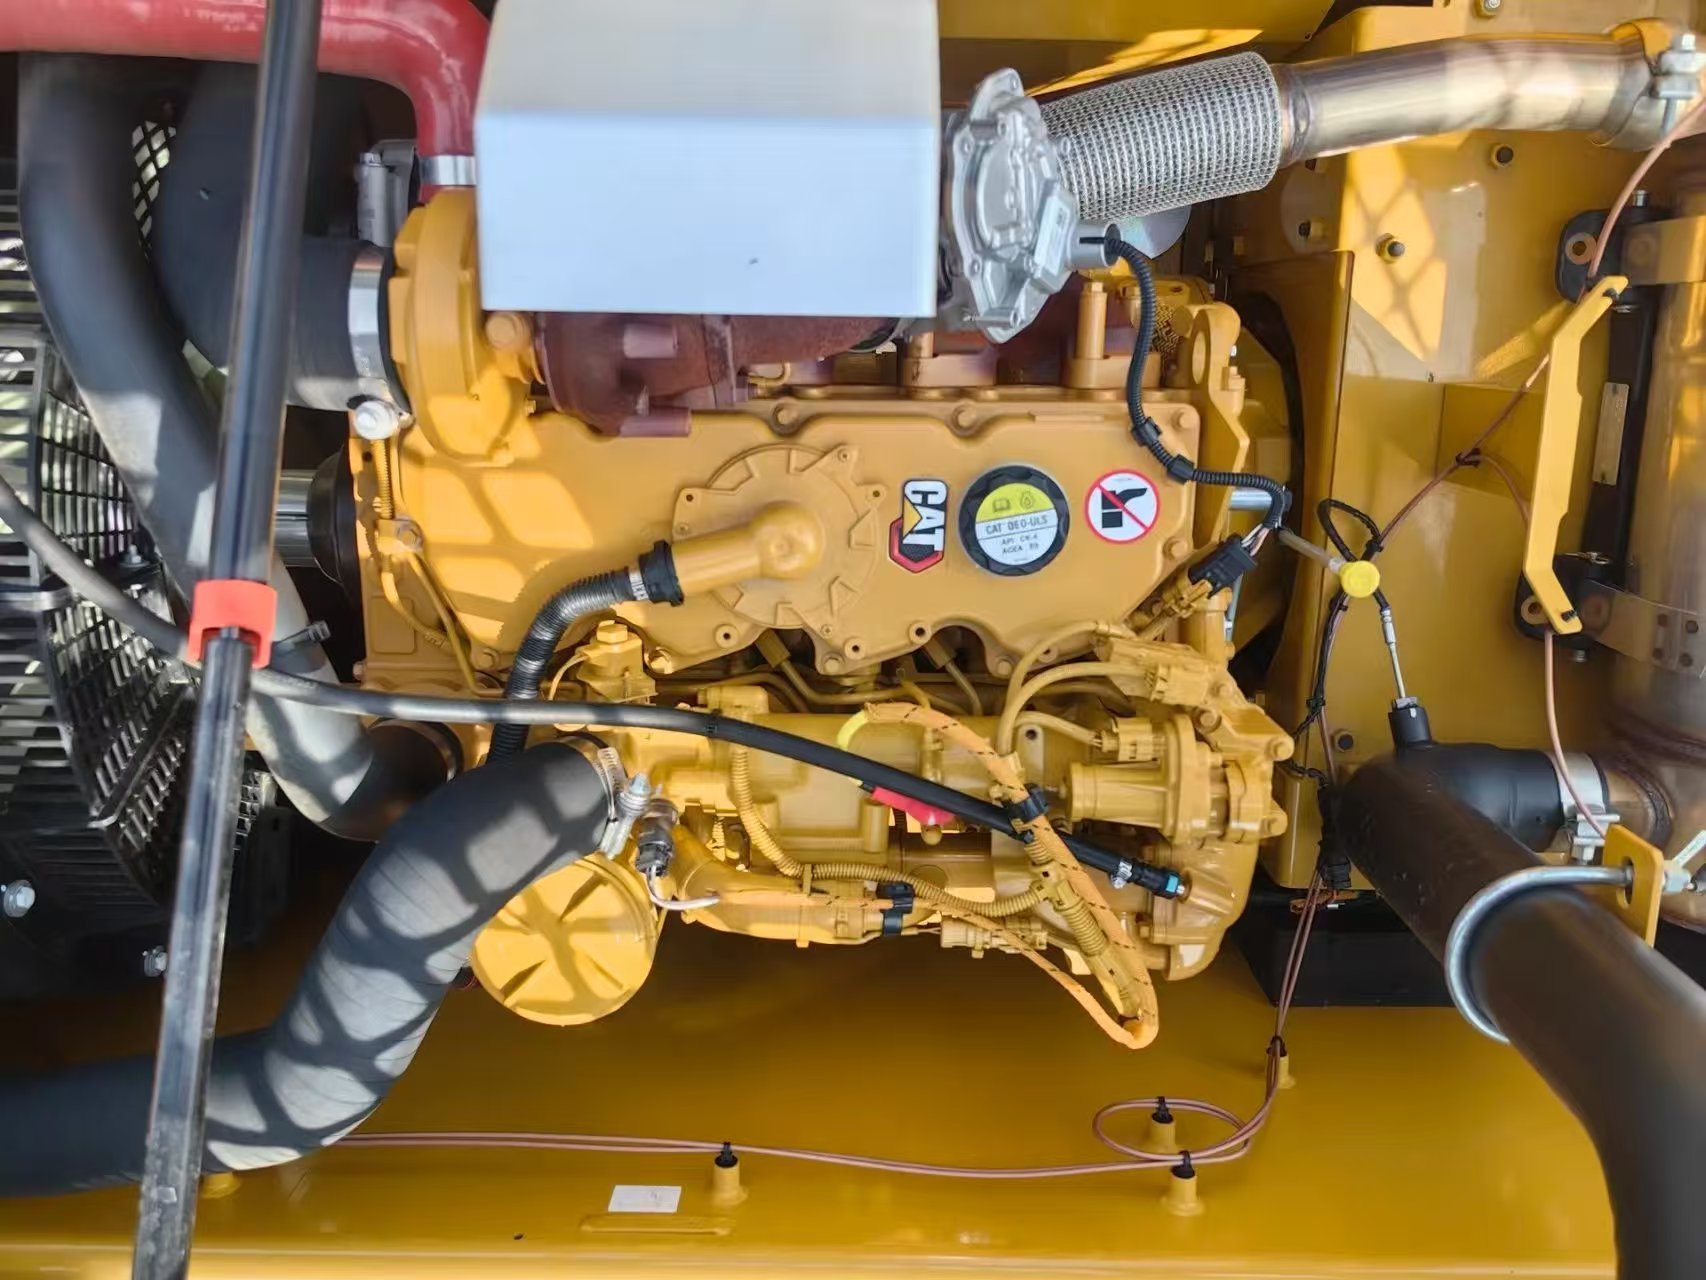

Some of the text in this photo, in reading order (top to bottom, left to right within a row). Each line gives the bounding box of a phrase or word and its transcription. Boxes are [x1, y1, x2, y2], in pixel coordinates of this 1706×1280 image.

[903, 480, 947, 552] CAT
[985, 514, 1048, 535] CAT DEO-ULS
